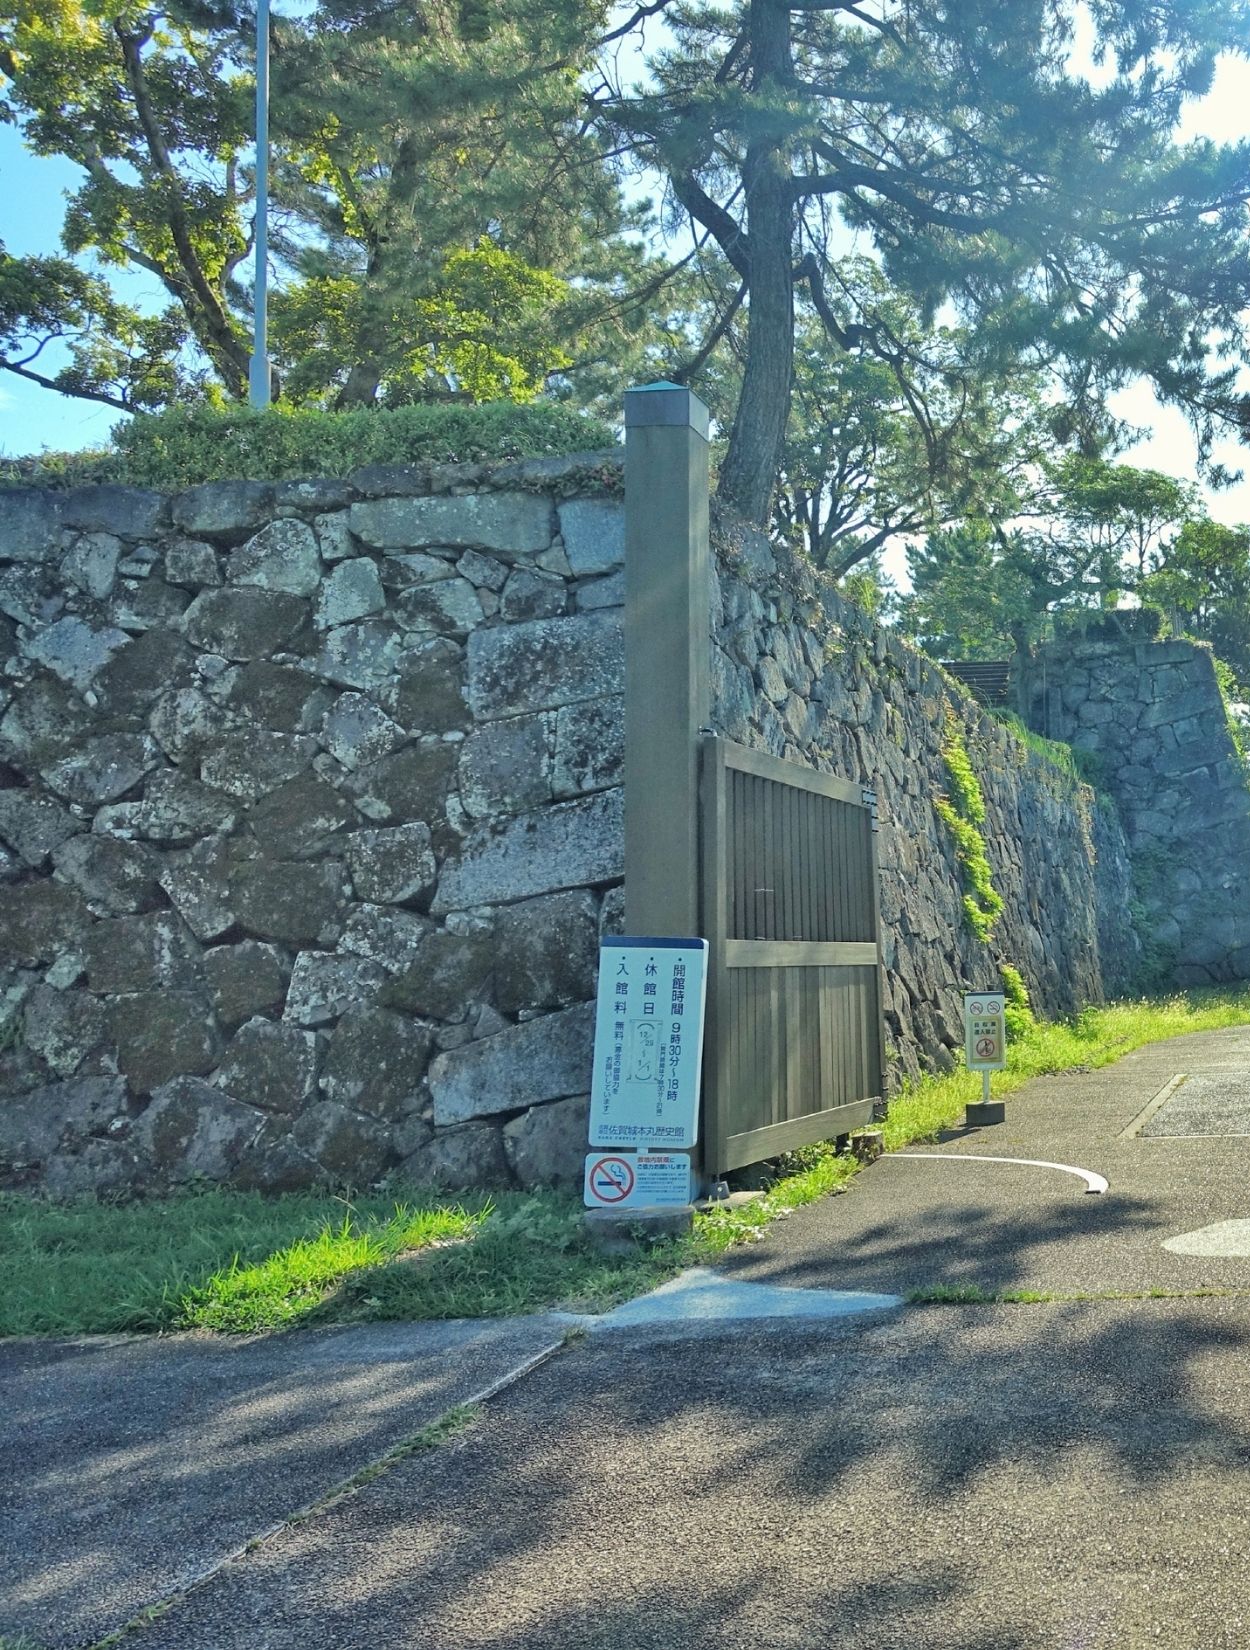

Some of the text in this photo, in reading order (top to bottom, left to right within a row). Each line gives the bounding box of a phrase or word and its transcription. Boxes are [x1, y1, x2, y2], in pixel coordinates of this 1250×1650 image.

[614, 963, 629, 1015] 入館料
[643, 963, 657, 1015] 休館日
[671, 964, 686, 1016] 開館時間
